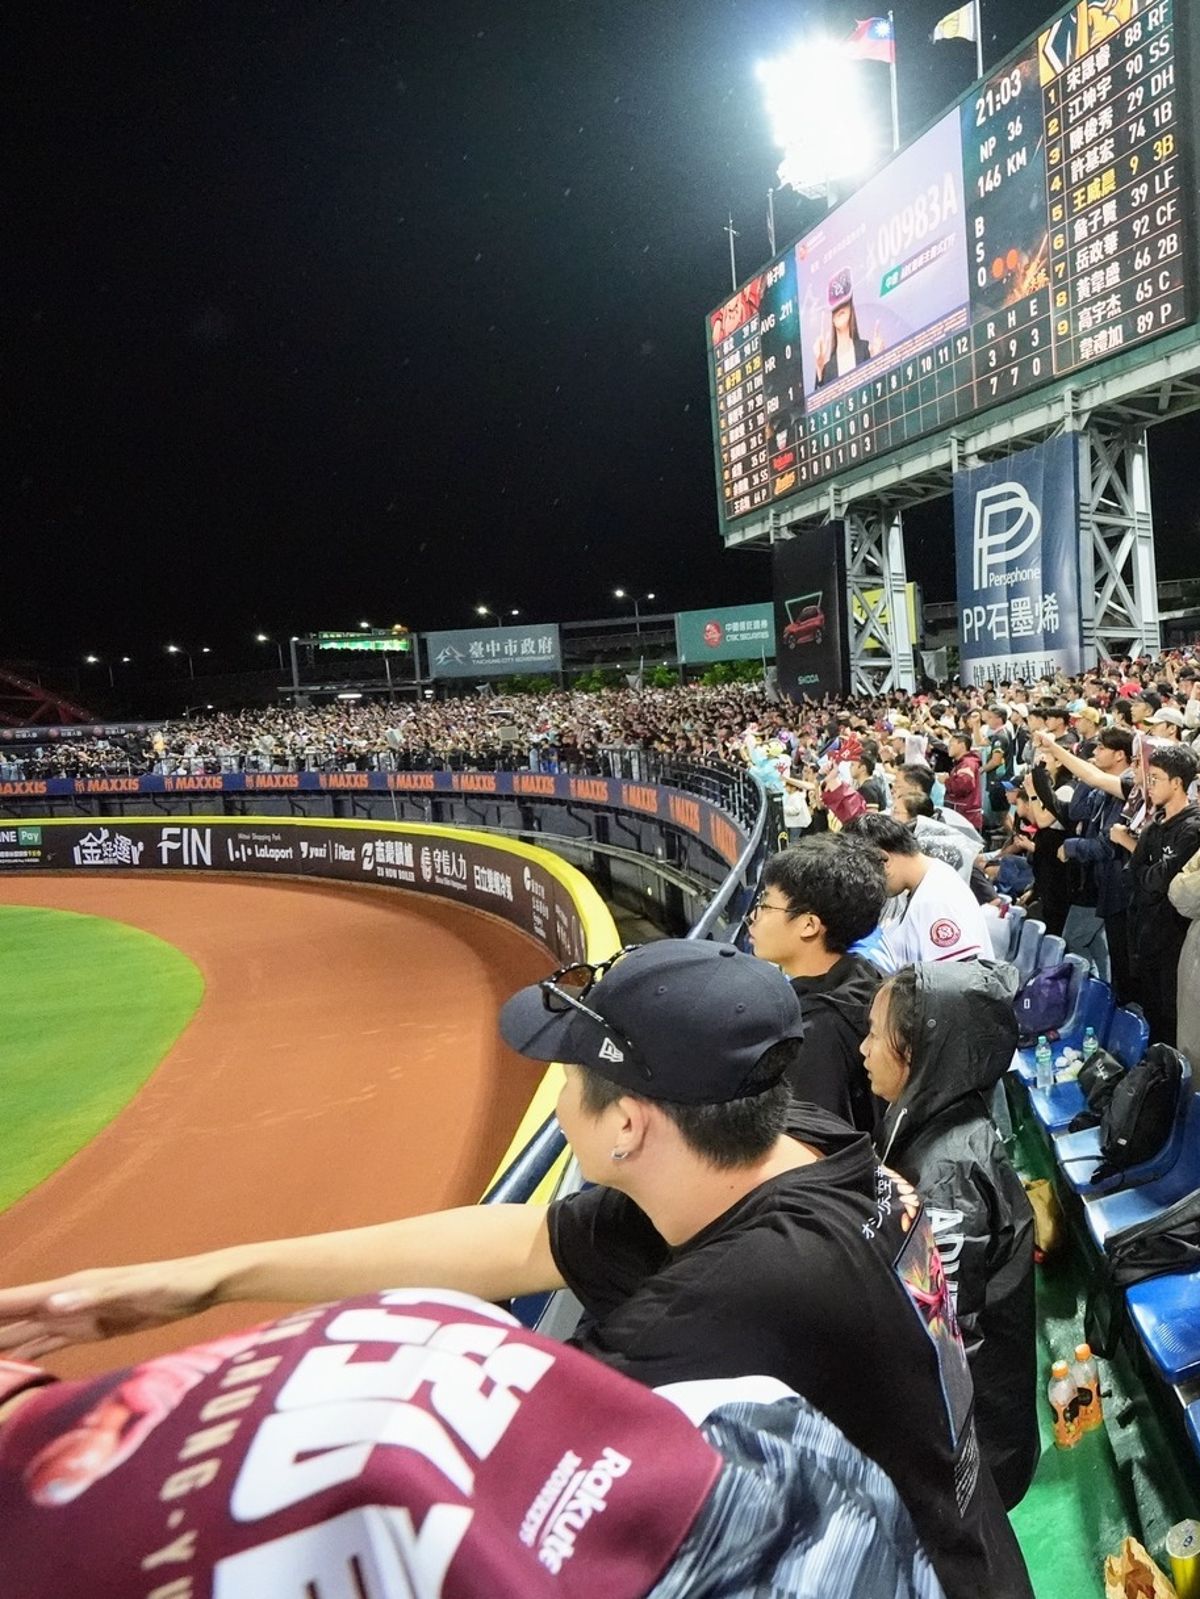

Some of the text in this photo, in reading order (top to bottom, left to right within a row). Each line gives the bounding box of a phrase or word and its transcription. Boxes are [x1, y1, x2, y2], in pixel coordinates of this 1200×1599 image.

[1048, 89, 1055, 104] 1
[1125, 21, 1142, 48] 88
[1148, 2, 1168, 31] RF
[975, 69, 1022, 127] 21:03
[1048, 35, 1170, 136] 2 江坤宇 90 SS
[1049, 65, 1174, 165] 3 陳俊秀 29 DH
[979, 115, 1023, 163] NP 36
[1050, 101, 1172, 191] 4 許基宏 74 1B
[977, 146, 1027, 198] 146 KM
[1052, 134, 1174, 221] 5 王威晨 9 3B
[1053, 166, 1174, 250] 6 詹子賢 39 LF
[975, 216, 985, 238] B
[1055, 199, 1177, 279] 7 岳政華 92 CF
[976, 242, 985, 263] S
[1056, 291, 1067, 308] 8
[1134, 247, 1151, 271] 66
[1158, 233, 1178, 259] 2B
[1058, 271, 1170, 336] 9 高宇杰 65 C
[1137, 311, 1154, 333] 89
[1160, 303, 1172, 324] P
[761, 313, 775, 336] AVG
[785, 345, 792, 360] 0
[799, 298, 1038, 437] 1 2 3 4 5 6 7 8 9 10 11 12 R H E
[788, 386, 794, 401] 1
[800, 328, 1039, 459] 1 2 0 0 0 0 3 9 3
[801, 357, 1041, 480] 3 0 0 1 0 3 7 7 0
[989, 566, 1041, 588] Persephone
[963, 592, 1060, 644] PP石墨烯
[468, 636, 553, 658] 臺中市政府
[87, 777, 140, 792] MAXXIS
[175, 775, 223, 790] MAXXIS
[256, 774, 299, 788] MAXXIS
[329, 774, 369, 789] MAXXIS
[396, 774, 434, 789] MAXXIS
[461, 774, 496, 792] MAXXIS
[521, 775, 555, 795] MAXXIS
[577, 779, 608, 800] MAXXIS
[628, 785, 657, 813] MAXXIS
[0, 831, 39, 843] NE Pay
[157, 827, 212, 866] FIN
[255, 844, 293, 861] LaLaport
[433, 848, 466, 881] 守信人力
